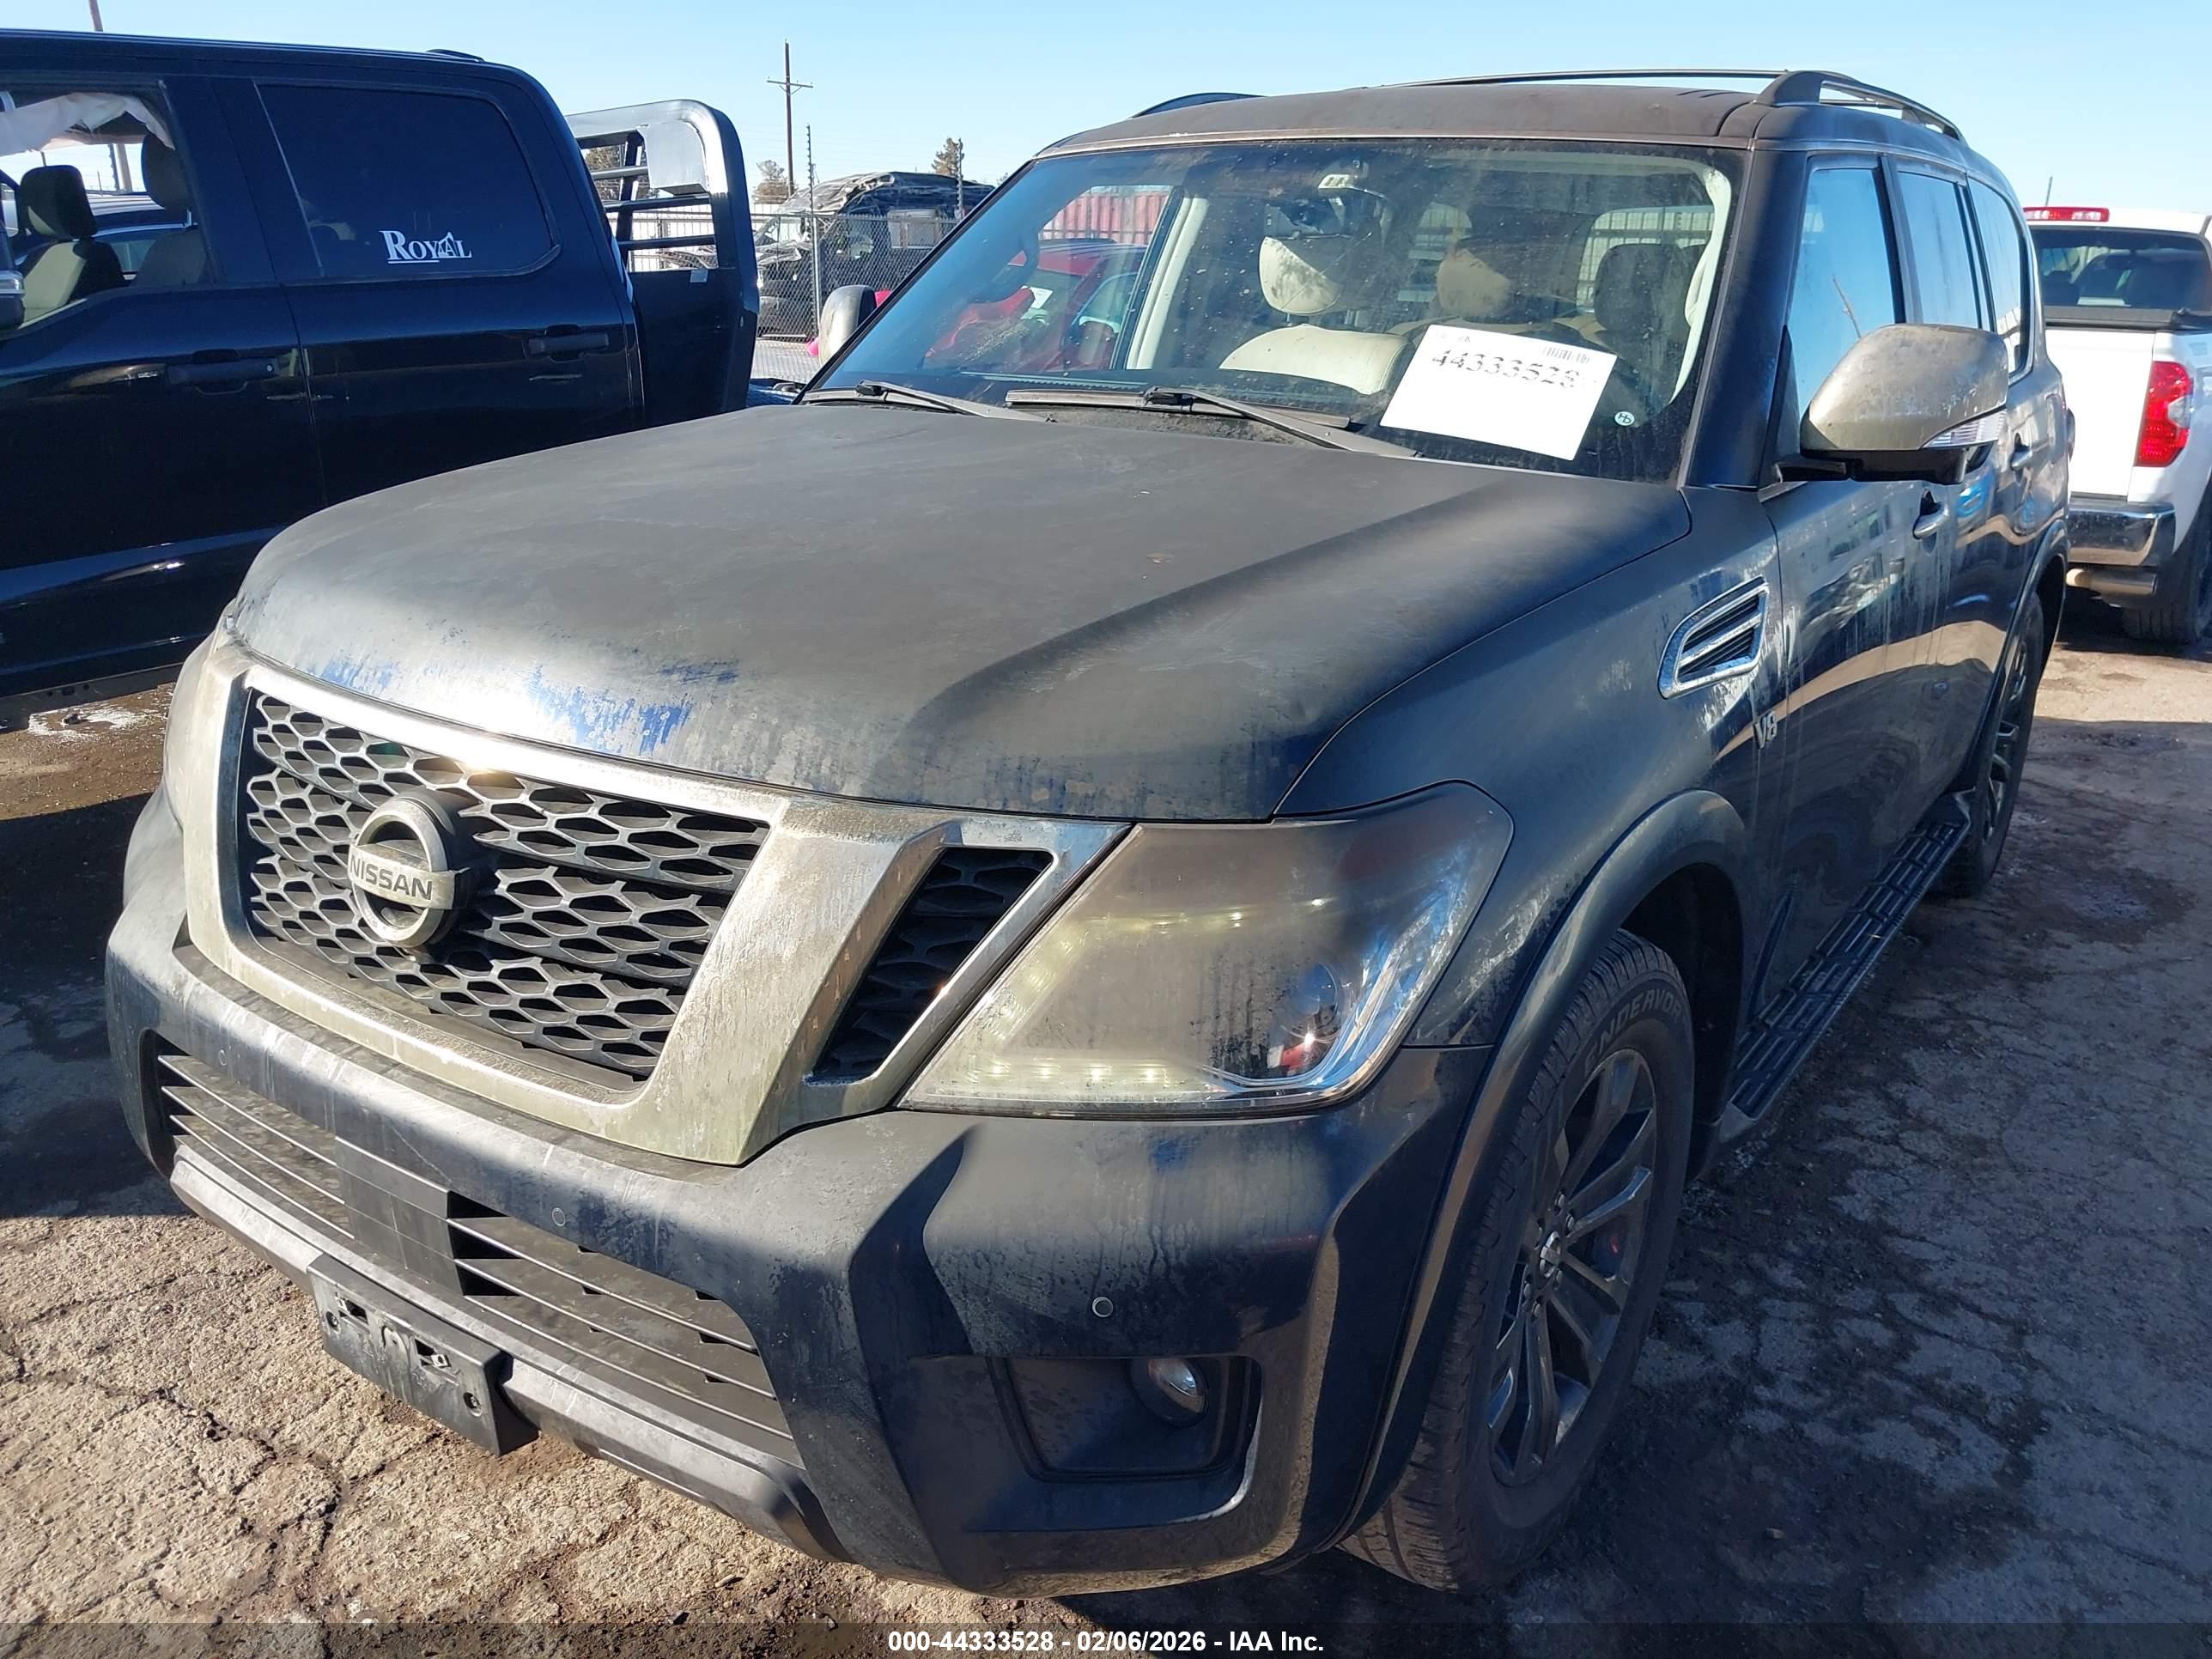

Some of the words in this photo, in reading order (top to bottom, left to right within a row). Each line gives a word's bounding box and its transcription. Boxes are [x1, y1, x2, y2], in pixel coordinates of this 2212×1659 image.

[1431, 349, 1580, 388] 44333528
[1753, 710, 1778, 750] V8
[349, 854, 434, 902] NISSAN
[1584, 988, 1682, 1072] ENDEAVOR
